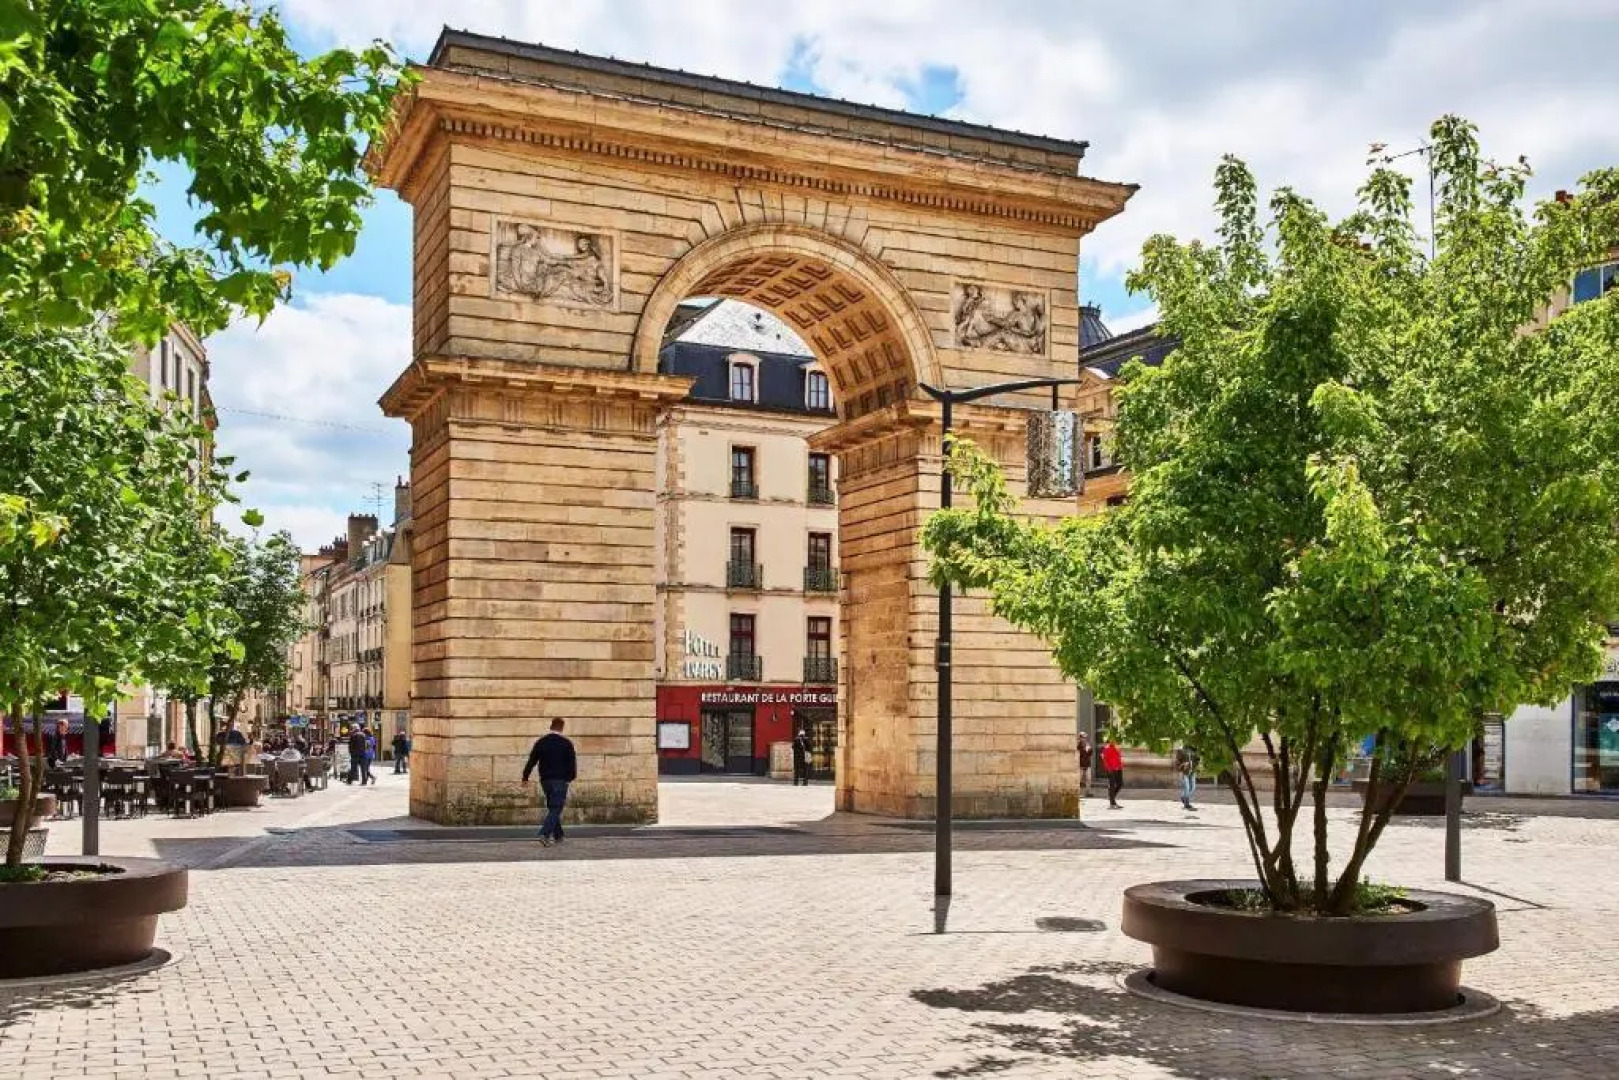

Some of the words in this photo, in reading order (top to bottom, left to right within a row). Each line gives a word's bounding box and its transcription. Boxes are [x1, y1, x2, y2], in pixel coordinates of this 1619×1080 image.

[701, 693, 759, 703] RESTAURANT
[762, 693, 774, 703] DE
[776, 693, 788, 703] LA
[790, 693, 817, 703] PORTE
